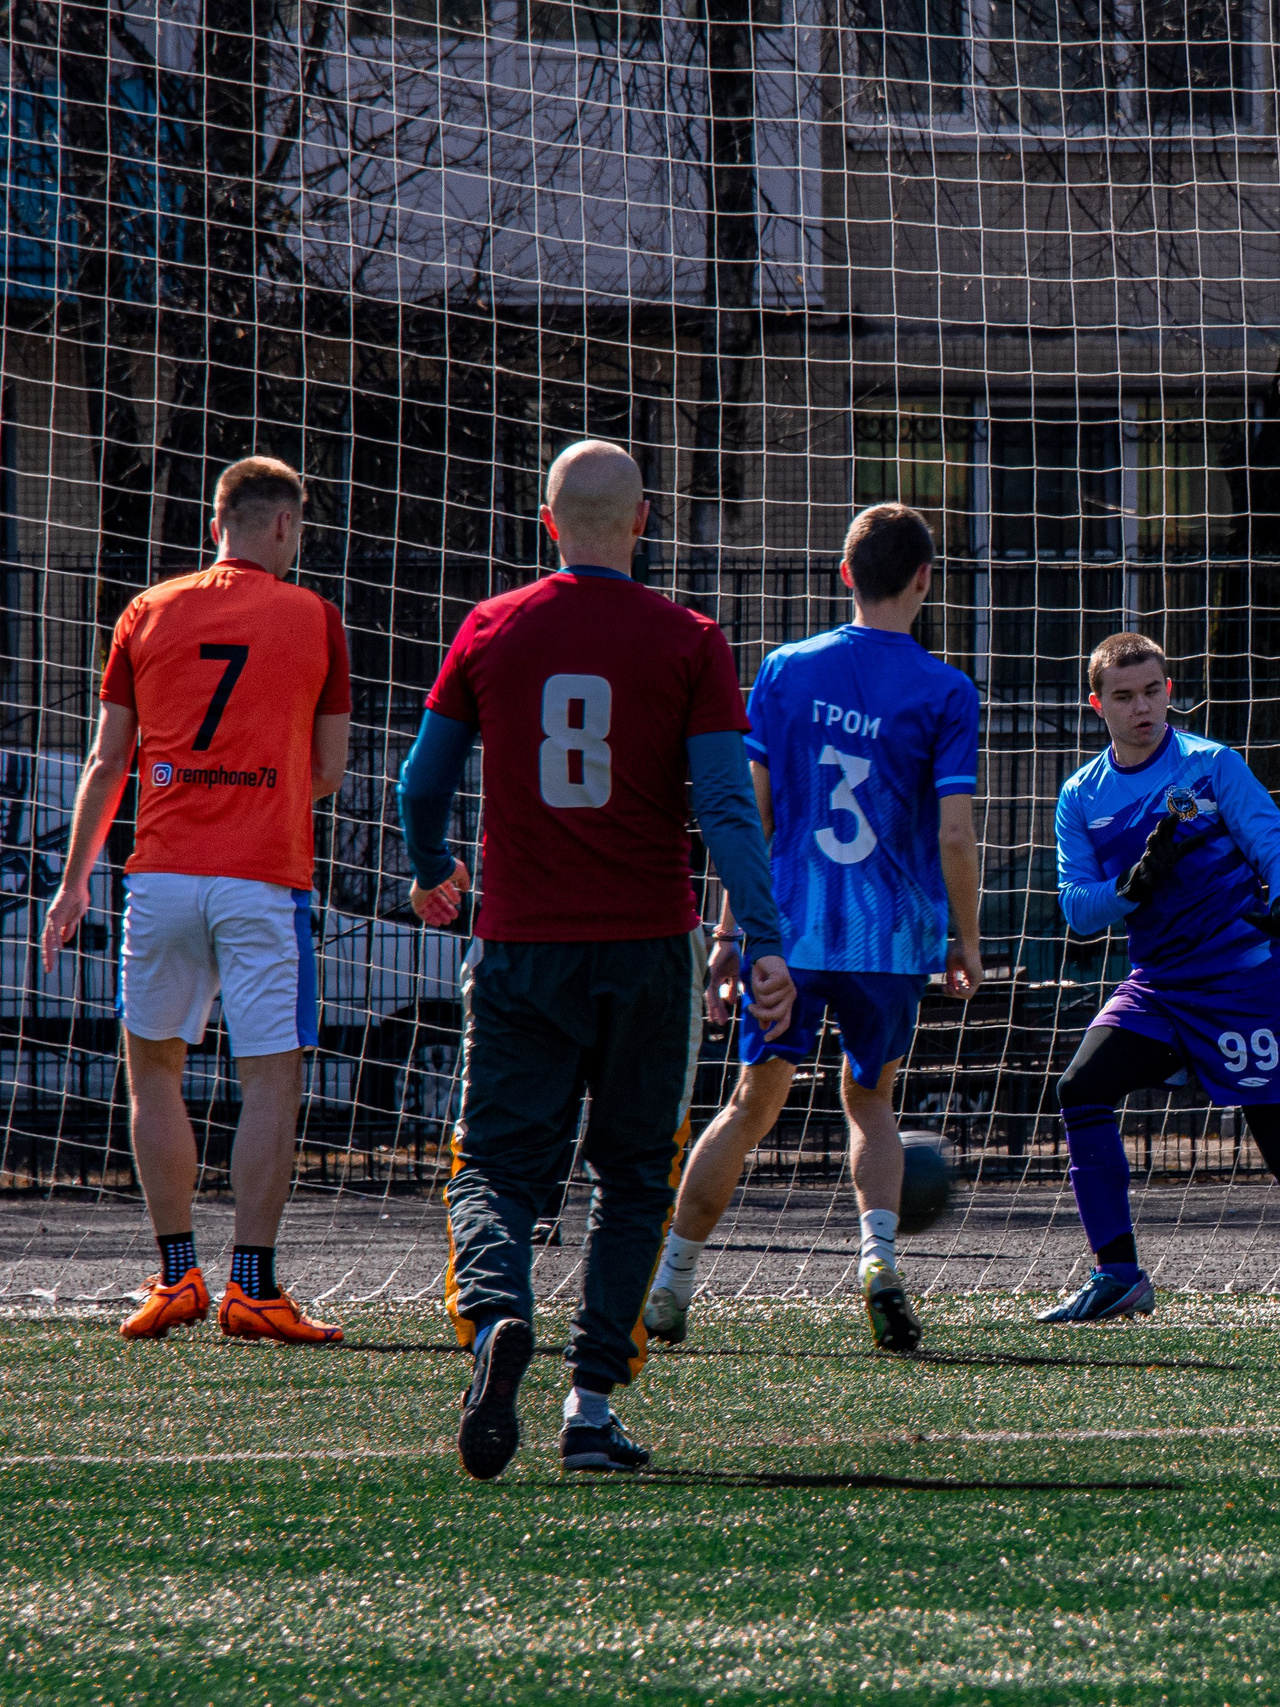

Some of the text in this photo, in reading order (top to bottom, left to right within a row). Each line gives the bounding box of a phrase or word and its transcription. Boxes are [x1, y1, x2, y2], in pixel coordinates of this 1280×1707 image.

[191, 643, 249, 751] 7
[812, 699, 882, 739] ГРОМ
[176, 764, 278, 789] remphone78
[539, 673, 612, 809] 8
[814, 745, 878, 865] 3
[1217, 1028, 1279, 1073] 99
